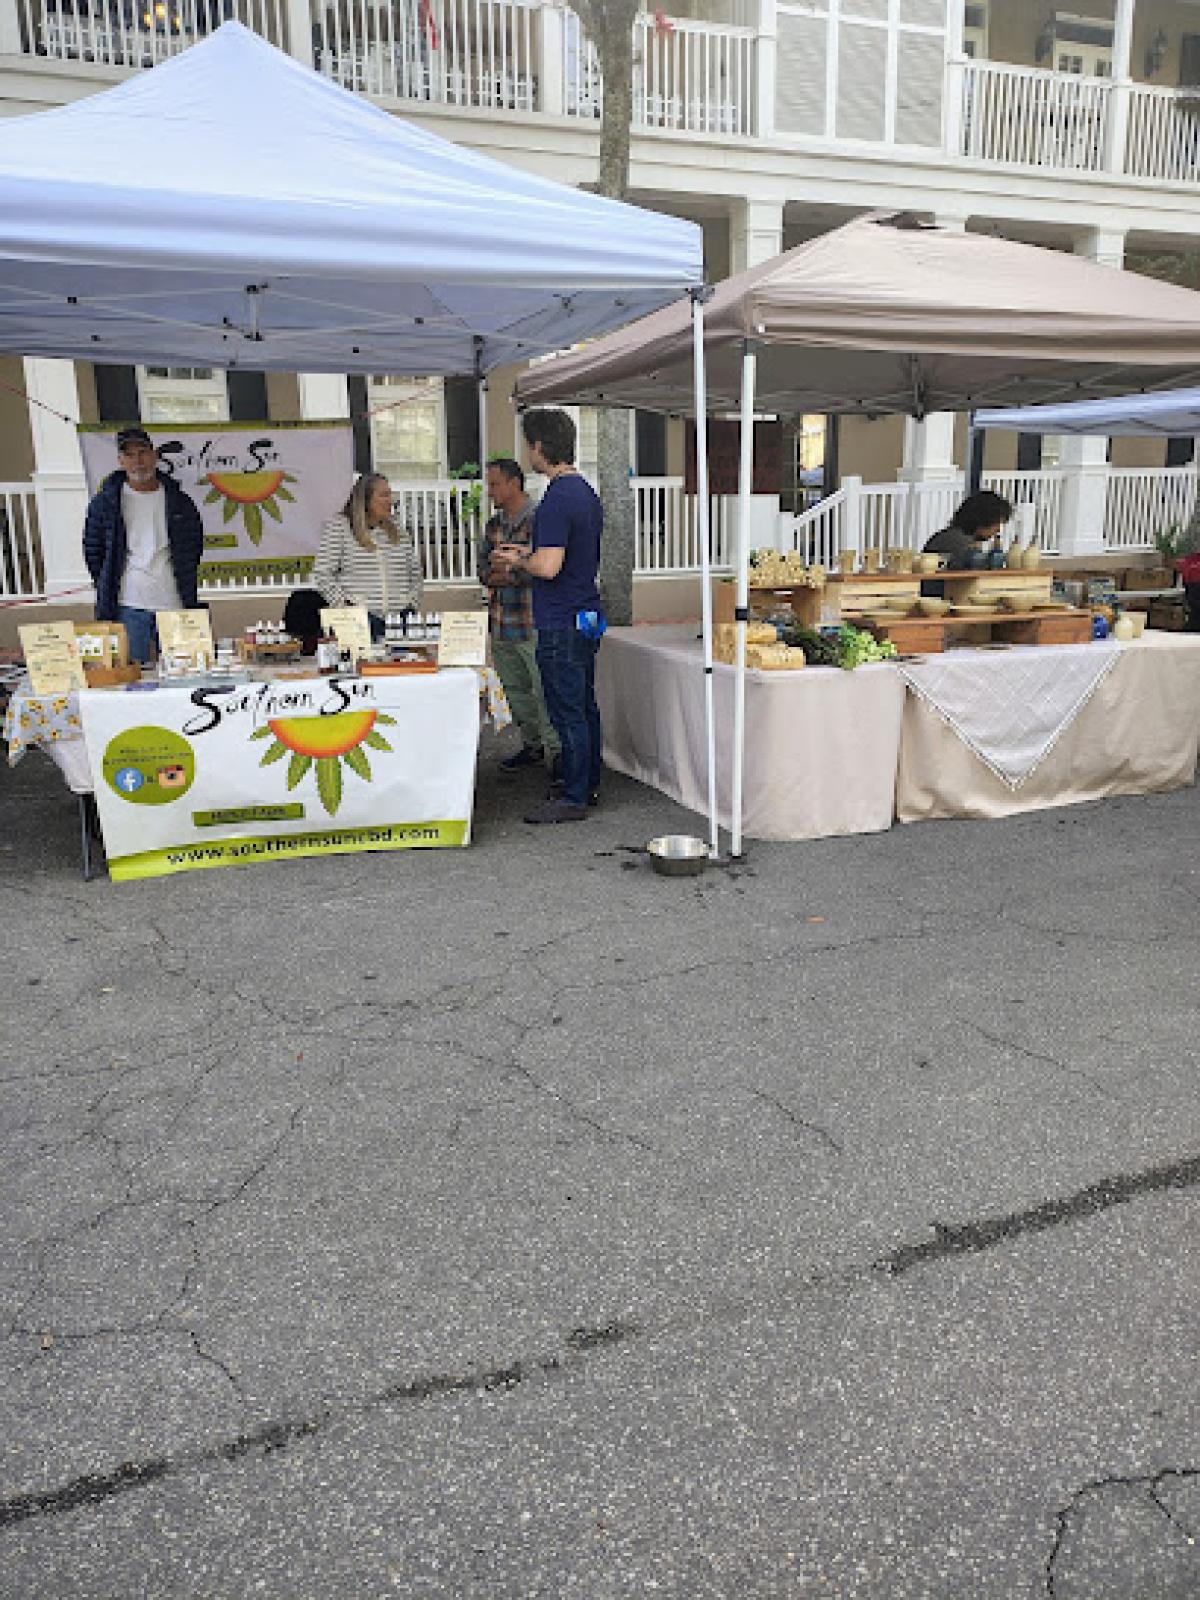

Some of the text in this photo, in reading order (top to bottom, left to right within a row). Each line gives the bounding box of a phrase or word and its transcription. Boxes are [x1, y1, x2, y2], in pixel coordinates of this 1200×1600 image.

[242, 438, 281, 474] Sun
[183, 679, 376, 736] Southern Sun
[167, 827, 440, 865] www.southernsuncbd.com
